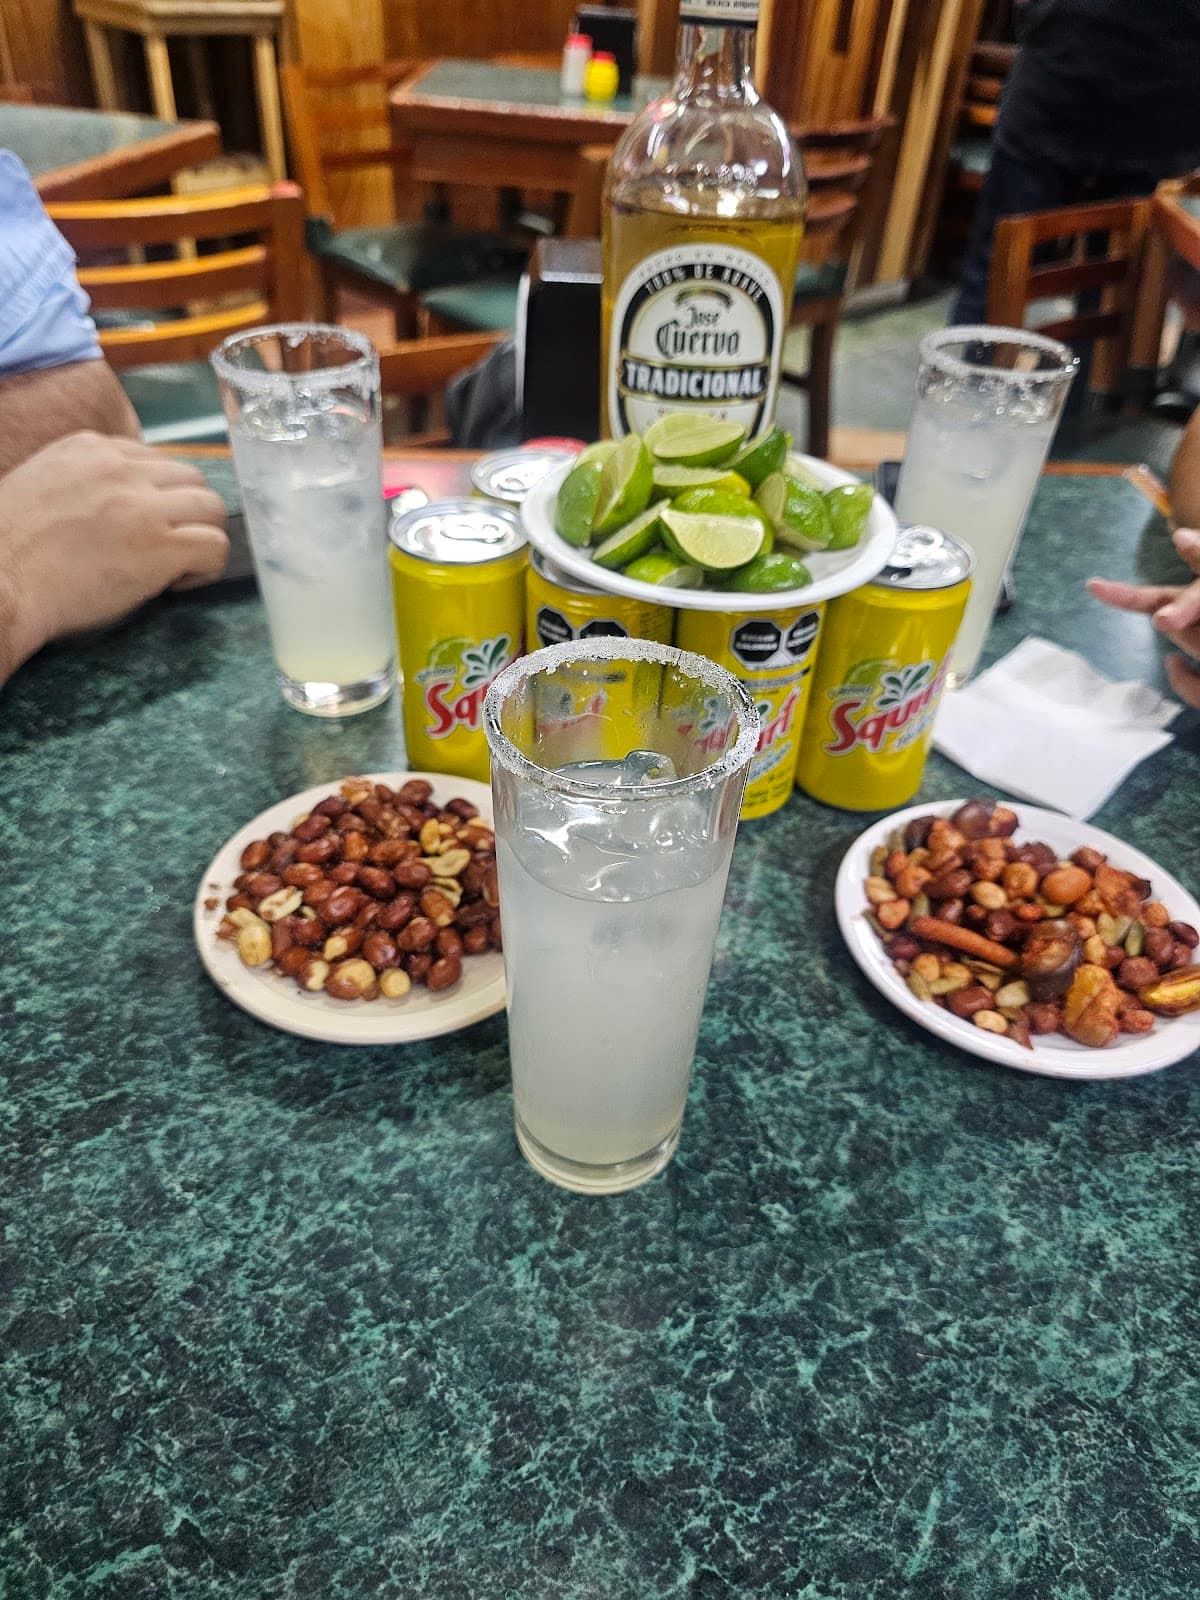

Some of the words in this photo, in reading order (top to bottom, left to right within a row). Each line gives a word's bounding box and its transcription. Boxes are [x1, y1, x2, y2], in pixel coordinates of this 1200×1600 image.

[645, 265, 686, 296] 100%
[693, 263, 713, 280] DE
[721, 266, 764, 303] AGAVE
[656, 319, 741, 361] Cuervo
[625, 361, 765, 399] TRADICIONAL
